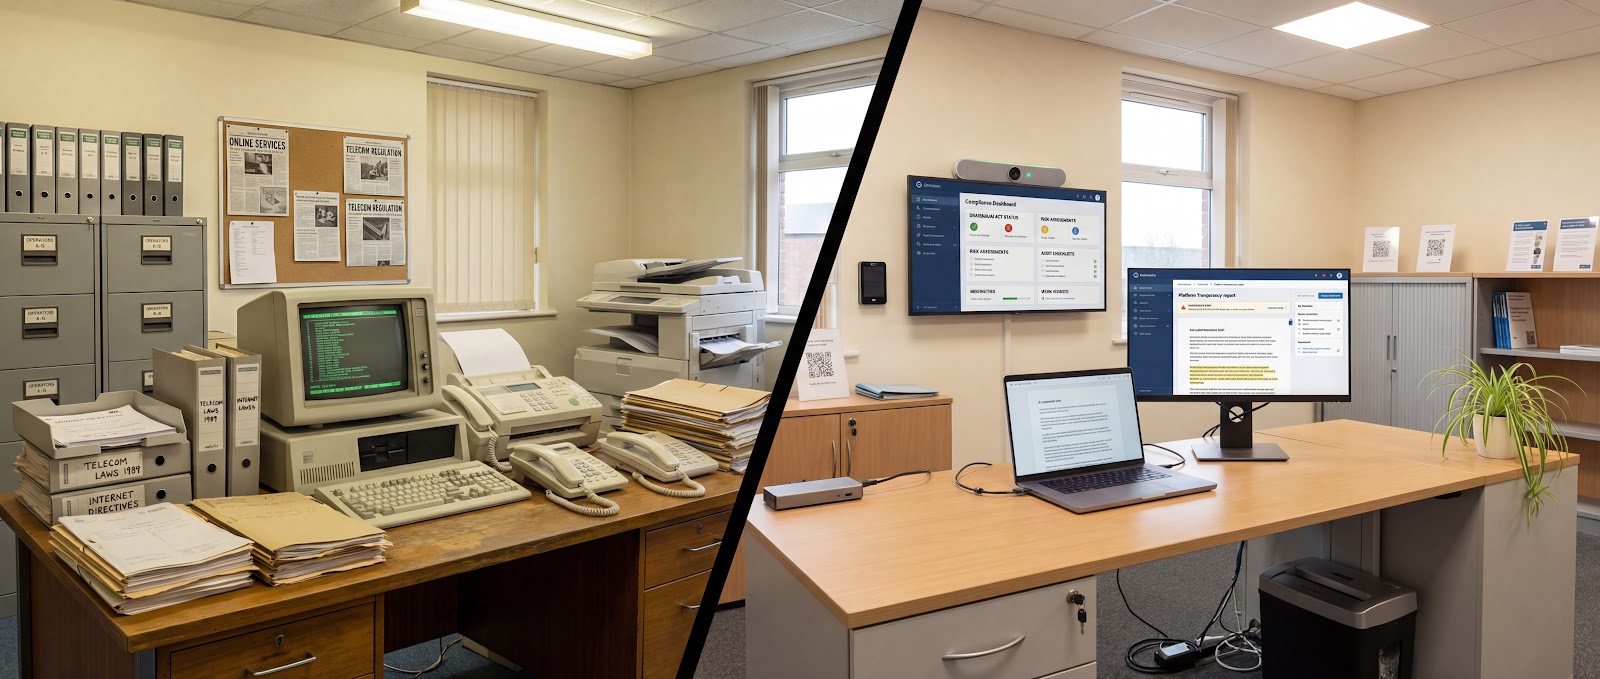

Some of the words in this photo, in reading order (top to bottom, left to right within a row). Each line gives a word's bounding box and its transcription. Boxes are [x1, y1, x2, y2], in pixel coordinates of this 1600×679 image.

[229, 137, 254, 148] ONLINE
[255, 139, 286, 150] SERVICES
[346, 145, 370, 155] TELECOM
[371, 147, 402, 157] REGULATION
[348, 203, 371, 212] TELECOM
[372, 204, 403, 213] REGULATION
[83, 457, 128, 471] TELECOM
[95, 469, 119, 480] LAWS
[123, 465, 141, 475] 1989
[89, 490, 134, 506] INTERNET
[88, 499, 139, 515] DIRECTIVES
